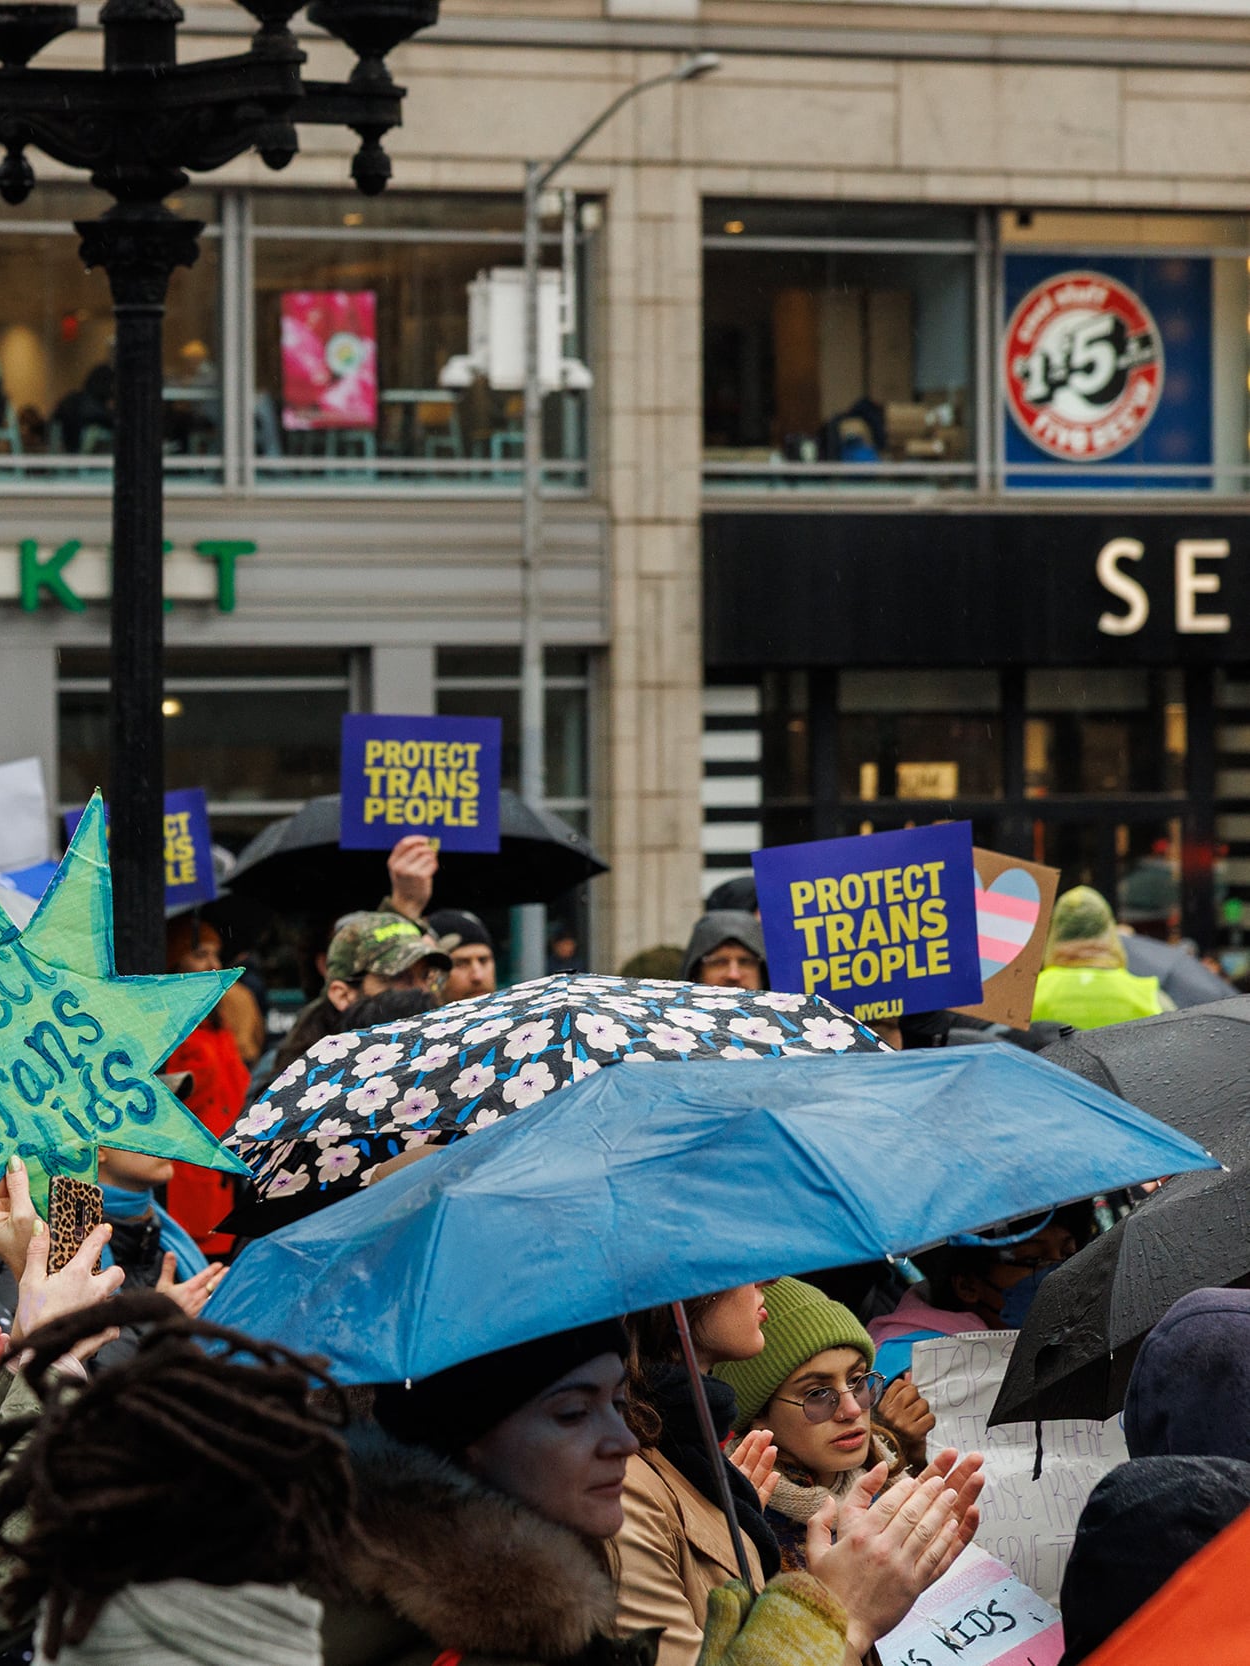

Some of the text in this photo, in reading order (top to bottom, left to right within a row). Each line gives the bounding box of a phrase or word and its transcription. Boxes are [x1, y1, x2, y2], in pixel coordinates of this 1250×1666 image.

[1096, 536, 1231, 637] SE
[364, 739, 481, 769] PROTECT
[363, 767, 480, 799] TRANS
[363, 797, 478, 827] PEOPLE
[790, 861, 945, 917] PROTECT
[793, 898, 949, 957] TRANS
[802, 938, 951, 994] PEOPLE
[854, 998, 904, 1022] NYCLU
[931, 1599, 1017, 1662] KIDS
